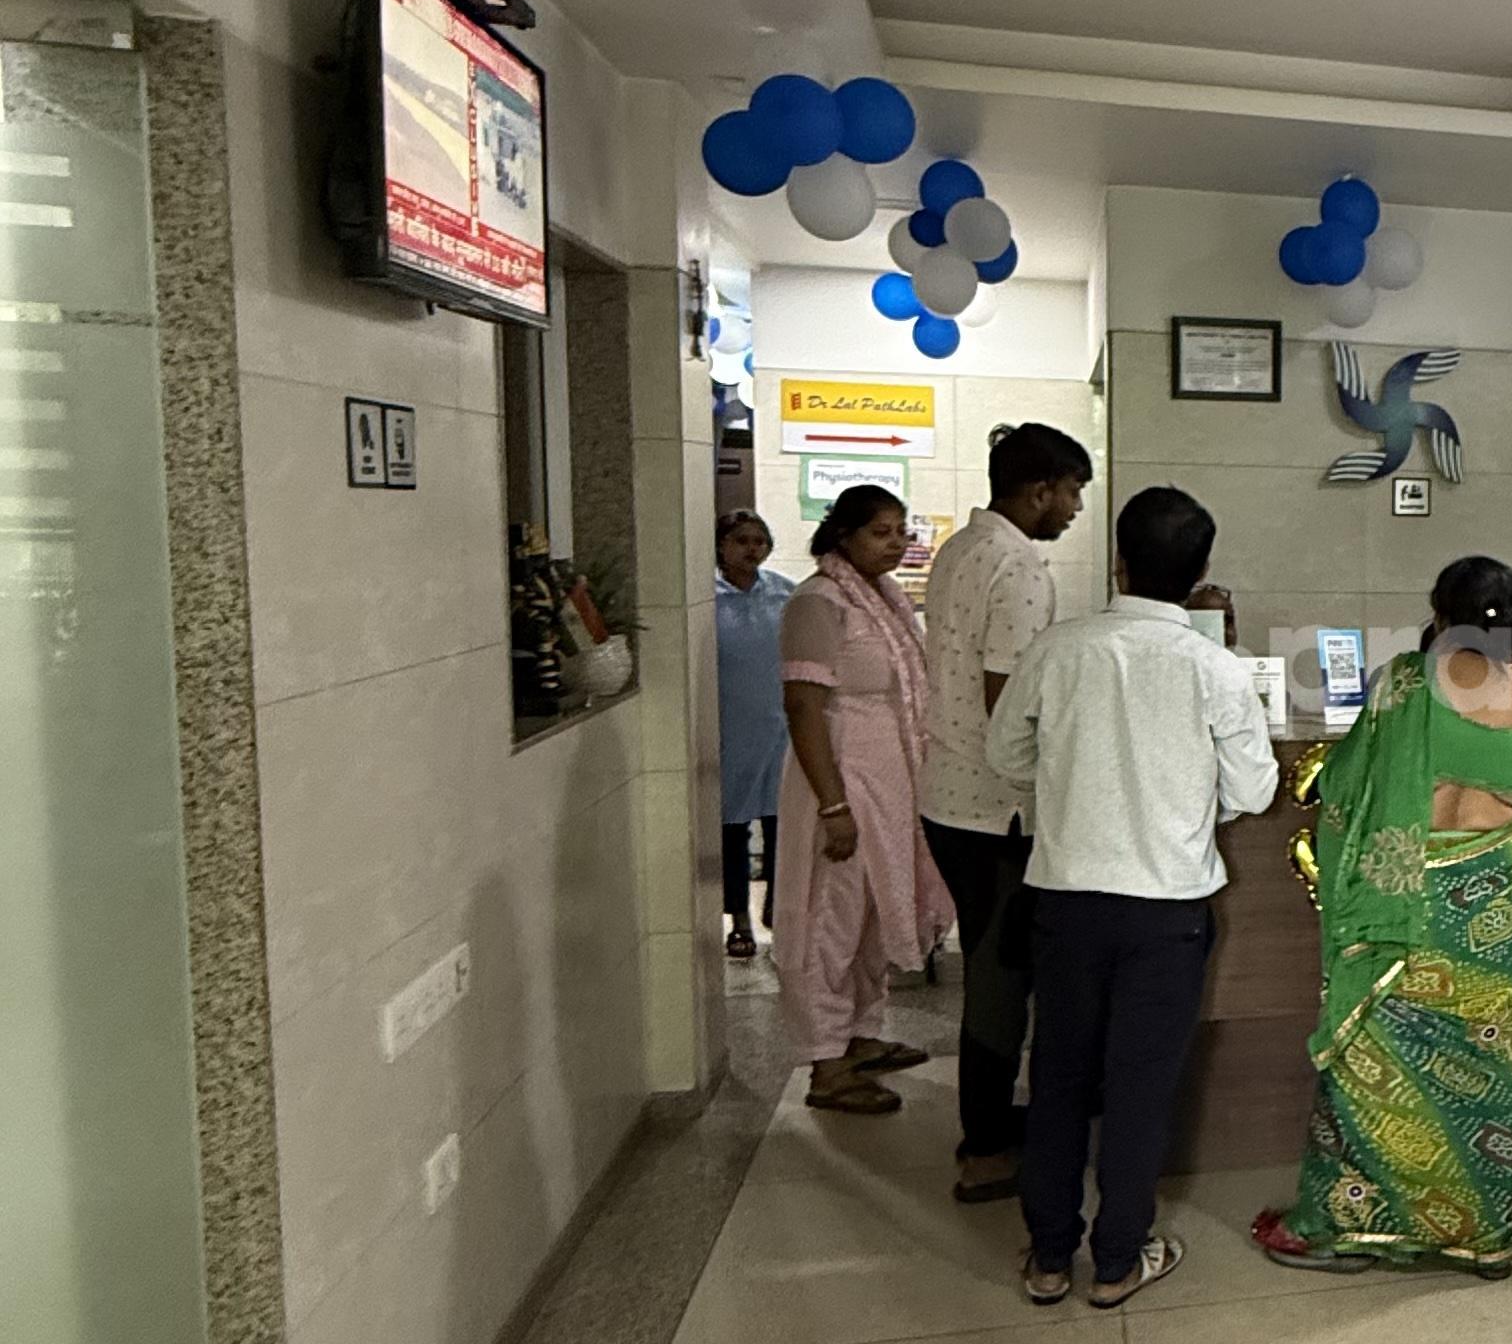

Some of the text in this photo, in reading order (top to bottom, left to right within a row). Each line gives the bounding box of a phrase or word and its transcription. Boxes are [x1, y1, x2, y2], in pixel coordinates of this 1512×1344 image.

[807, 394, 927, 413] Dr Lal PathLabs
[812, 470, 900, 488] Physiotherapy
